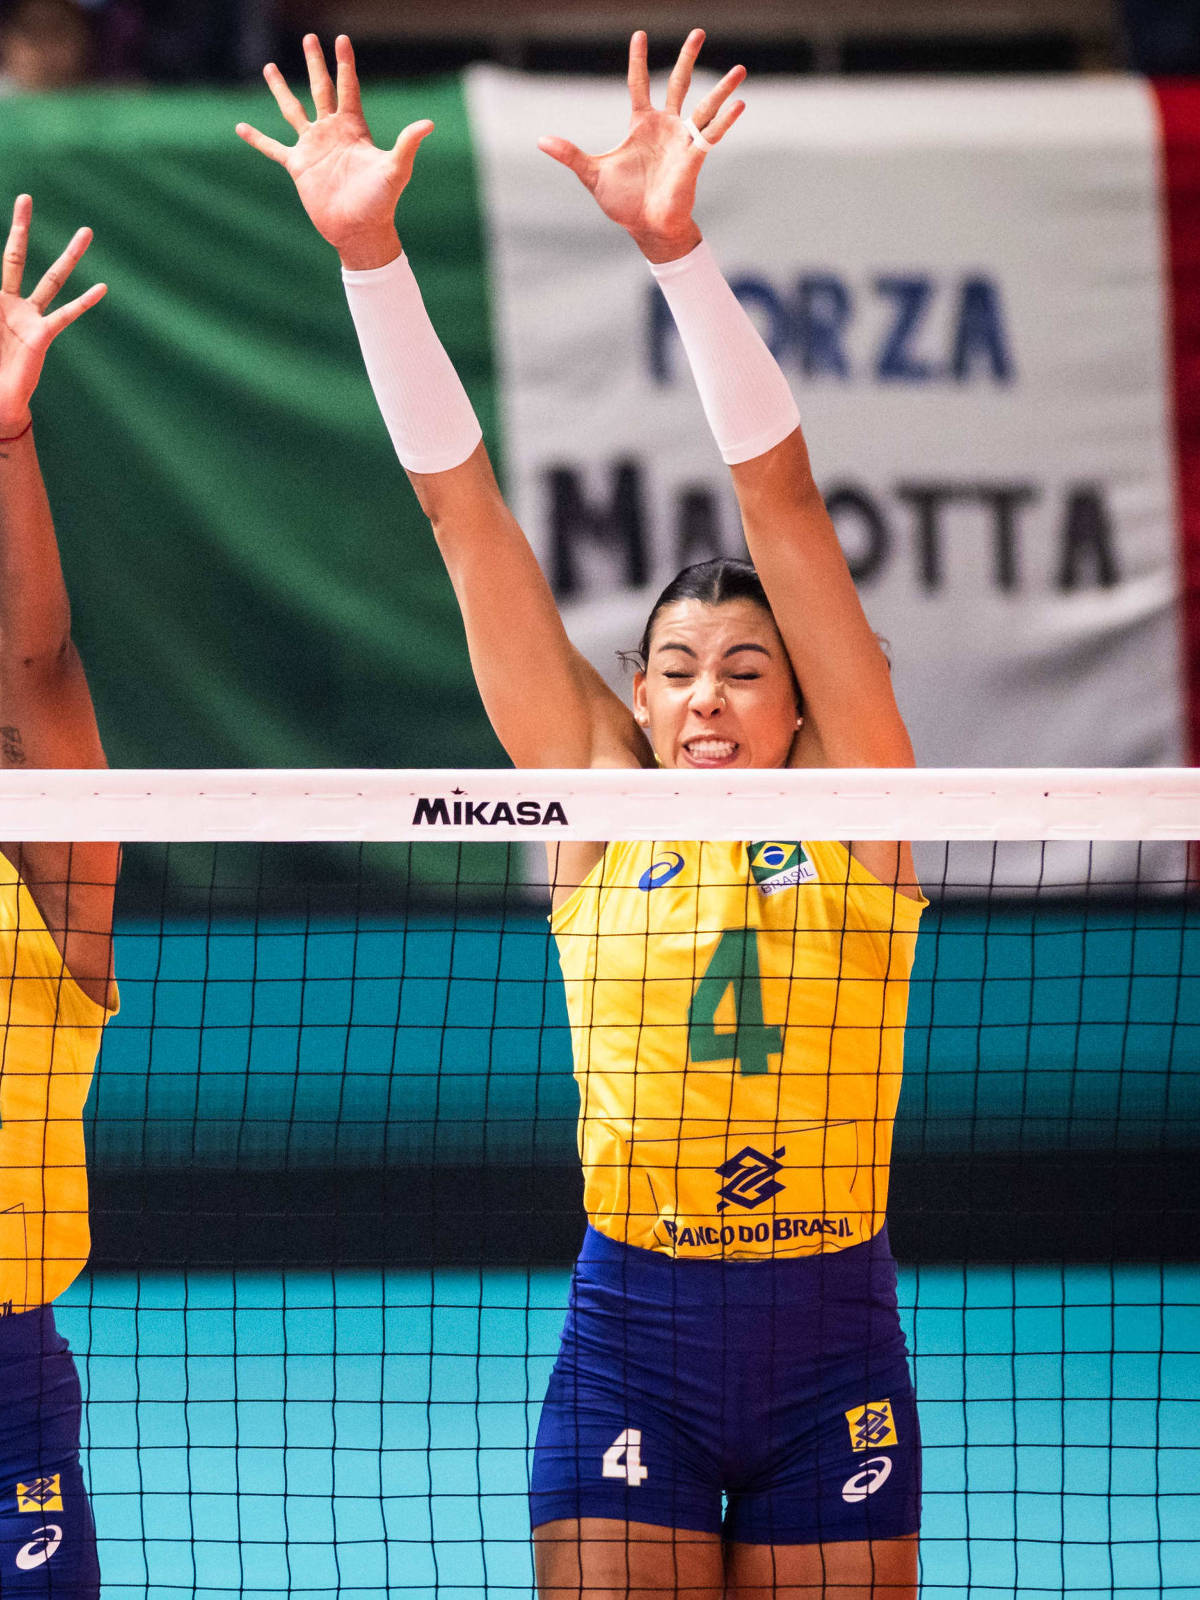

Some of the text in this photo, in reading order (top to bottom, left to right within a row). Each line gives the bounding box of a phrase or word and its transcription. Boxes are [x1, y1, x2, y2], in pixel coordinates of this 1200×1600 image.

[542, 456, 1120, 604] MAOTTA
[412, 797, 569, 826] MIKASA
[760, 866, 814, 894] BRASIL
[687, 926, 783, 1077] 4
[662, 1217, 854, 1246] BANCO DO BRASIL
[602, 1428, 648, 1487] 4
